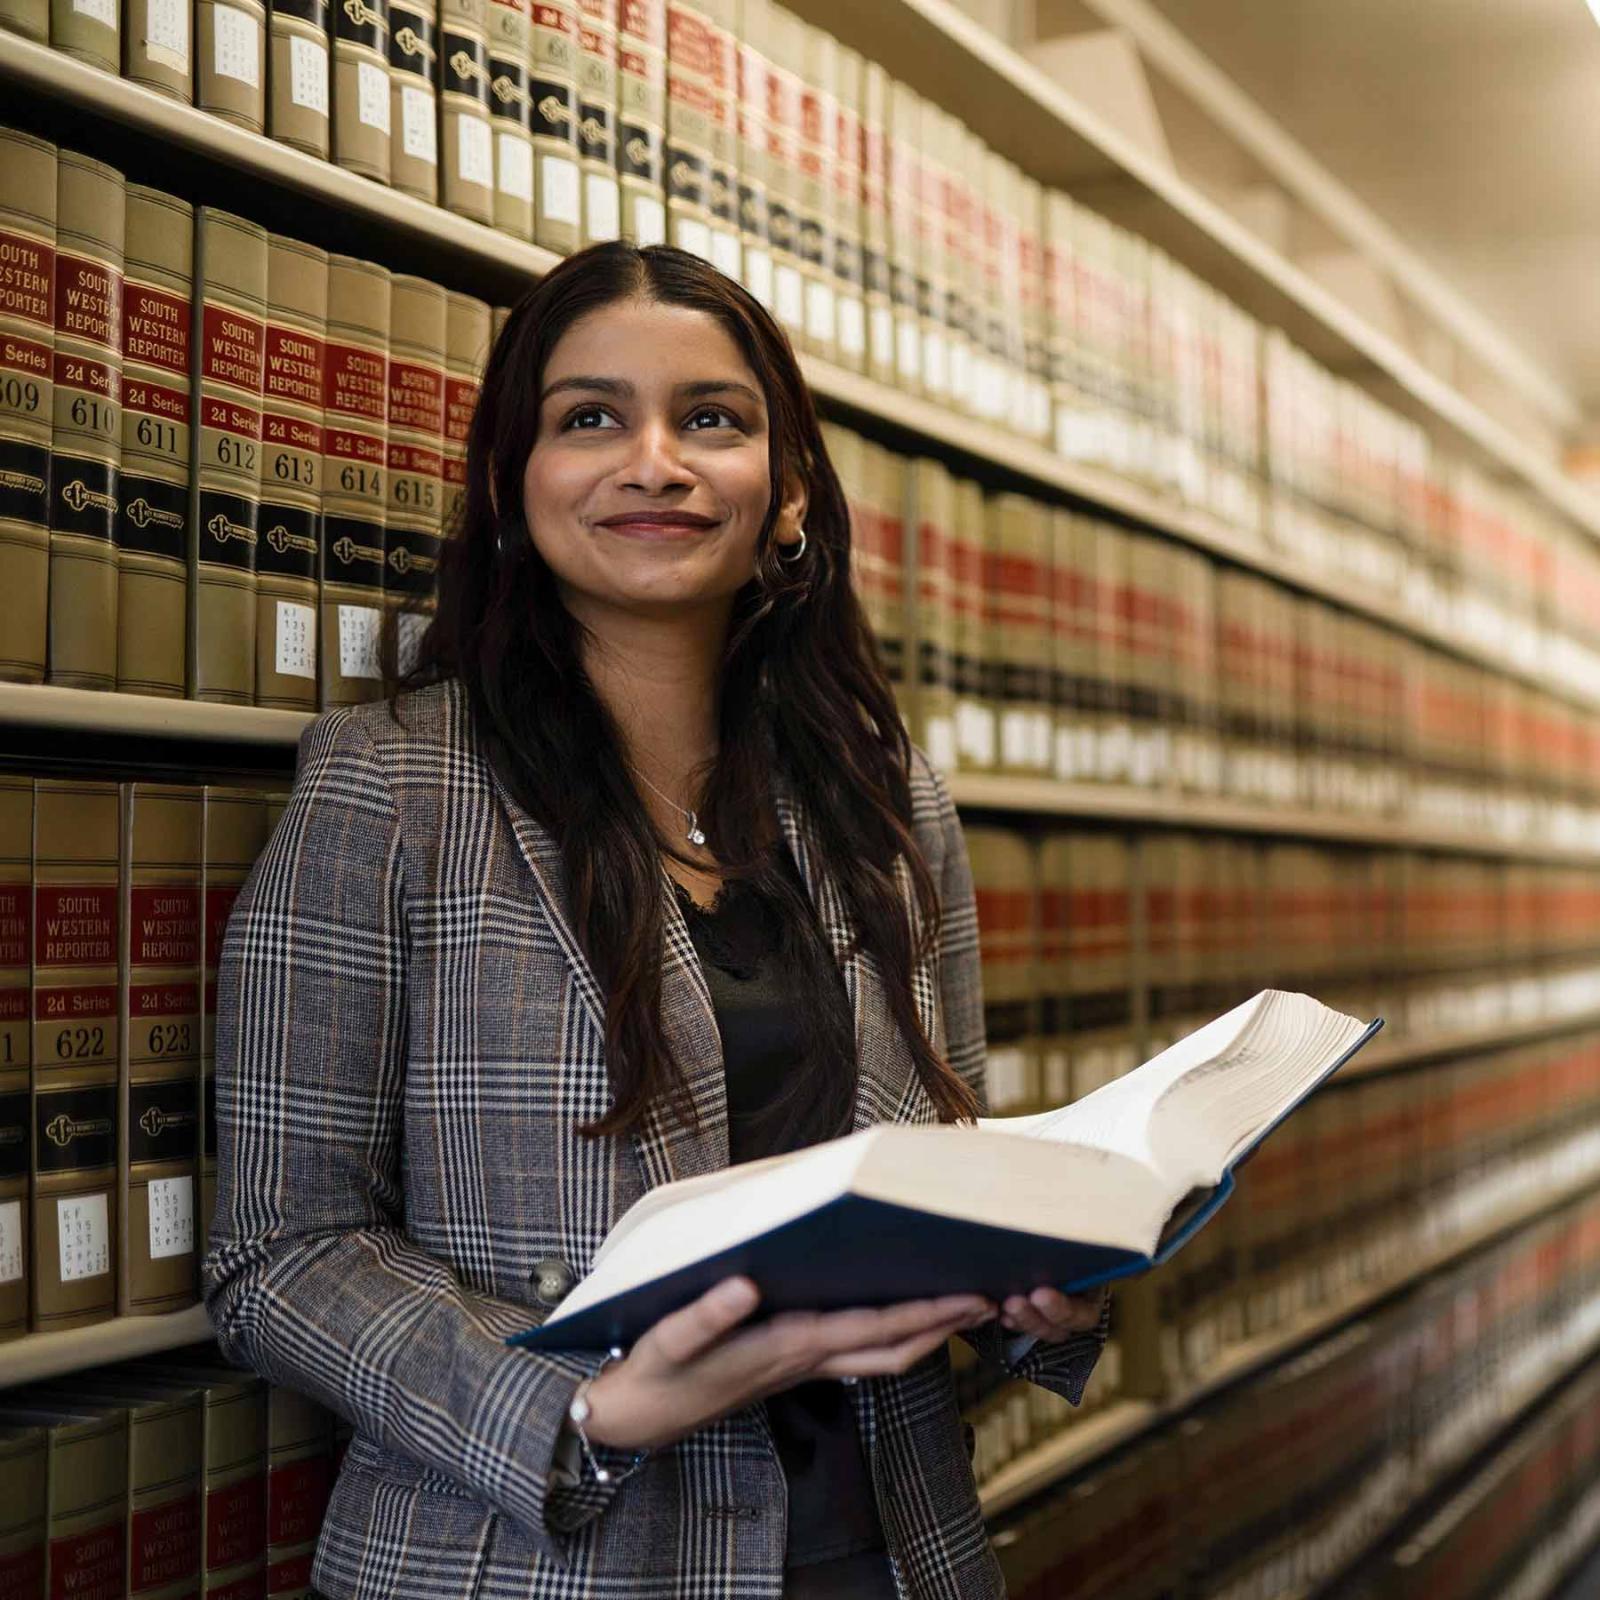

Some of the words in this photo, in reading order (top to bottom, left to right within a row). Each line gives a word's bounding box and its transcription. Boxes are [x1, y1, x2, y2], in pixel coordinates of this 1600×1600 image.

[0, 244, 38, 269] OUTH
[0, 266, 48, 294] STERN
[79, 271, 114, 298] SOUTH
[0, 288, 47, 317] PORTER
[140, 298, 178, 323] SOUTH
[129, 316, 186, 346] WESTERN
[222, 320, 255, 346] SOUTH
[5, 344, 46, 369] Series
[128, 337, 185, 367] REPORTER
[212, 337, 262, 366] WESTERN
[280, 338, 316, 361] SOUTH
[66, 364, 83, 381] 2d
[270, 355, 321, 382] WESTERN
[347, 355, 382, 376] SOUTH
[0, 377, 39, 412] 09
[269, 375, 321, 400] REPORTER
[336, 372, 384, 394] WESTER
[129, 388, 146, 403] 2d
[152, 393, 184, 416] Series
[72, 397, 114, 434] 610
[211, 407, 227, 422] 2d
[231, 412, 260, 433] Series
[138, 418, 177, 454] 611
[269, 421, 285, 437] 2d
[291, 426, 320, 447] Series
[336, 436, 351, 451] 2d
[218, 437, 255, 470] 612
[275, 453, 314, 485] 613
[340, 466, 380, 497] 614
[394, 478, 434, 508] 615
[57, 897, 100, 913] SOUTH
[153, 898, 190, 914] SOUTH
[46, 919, 111, 936] WESTERN
[46, 941, 110, 959] REPORTER
[47, 995, 65, 1012] 2d
[73, 994, 110, 1010] Series
[142, 993, 158, 1009] 2d
[57, 1026, 104, 1059] 622
[149, 1024, 190, 1054] 623
